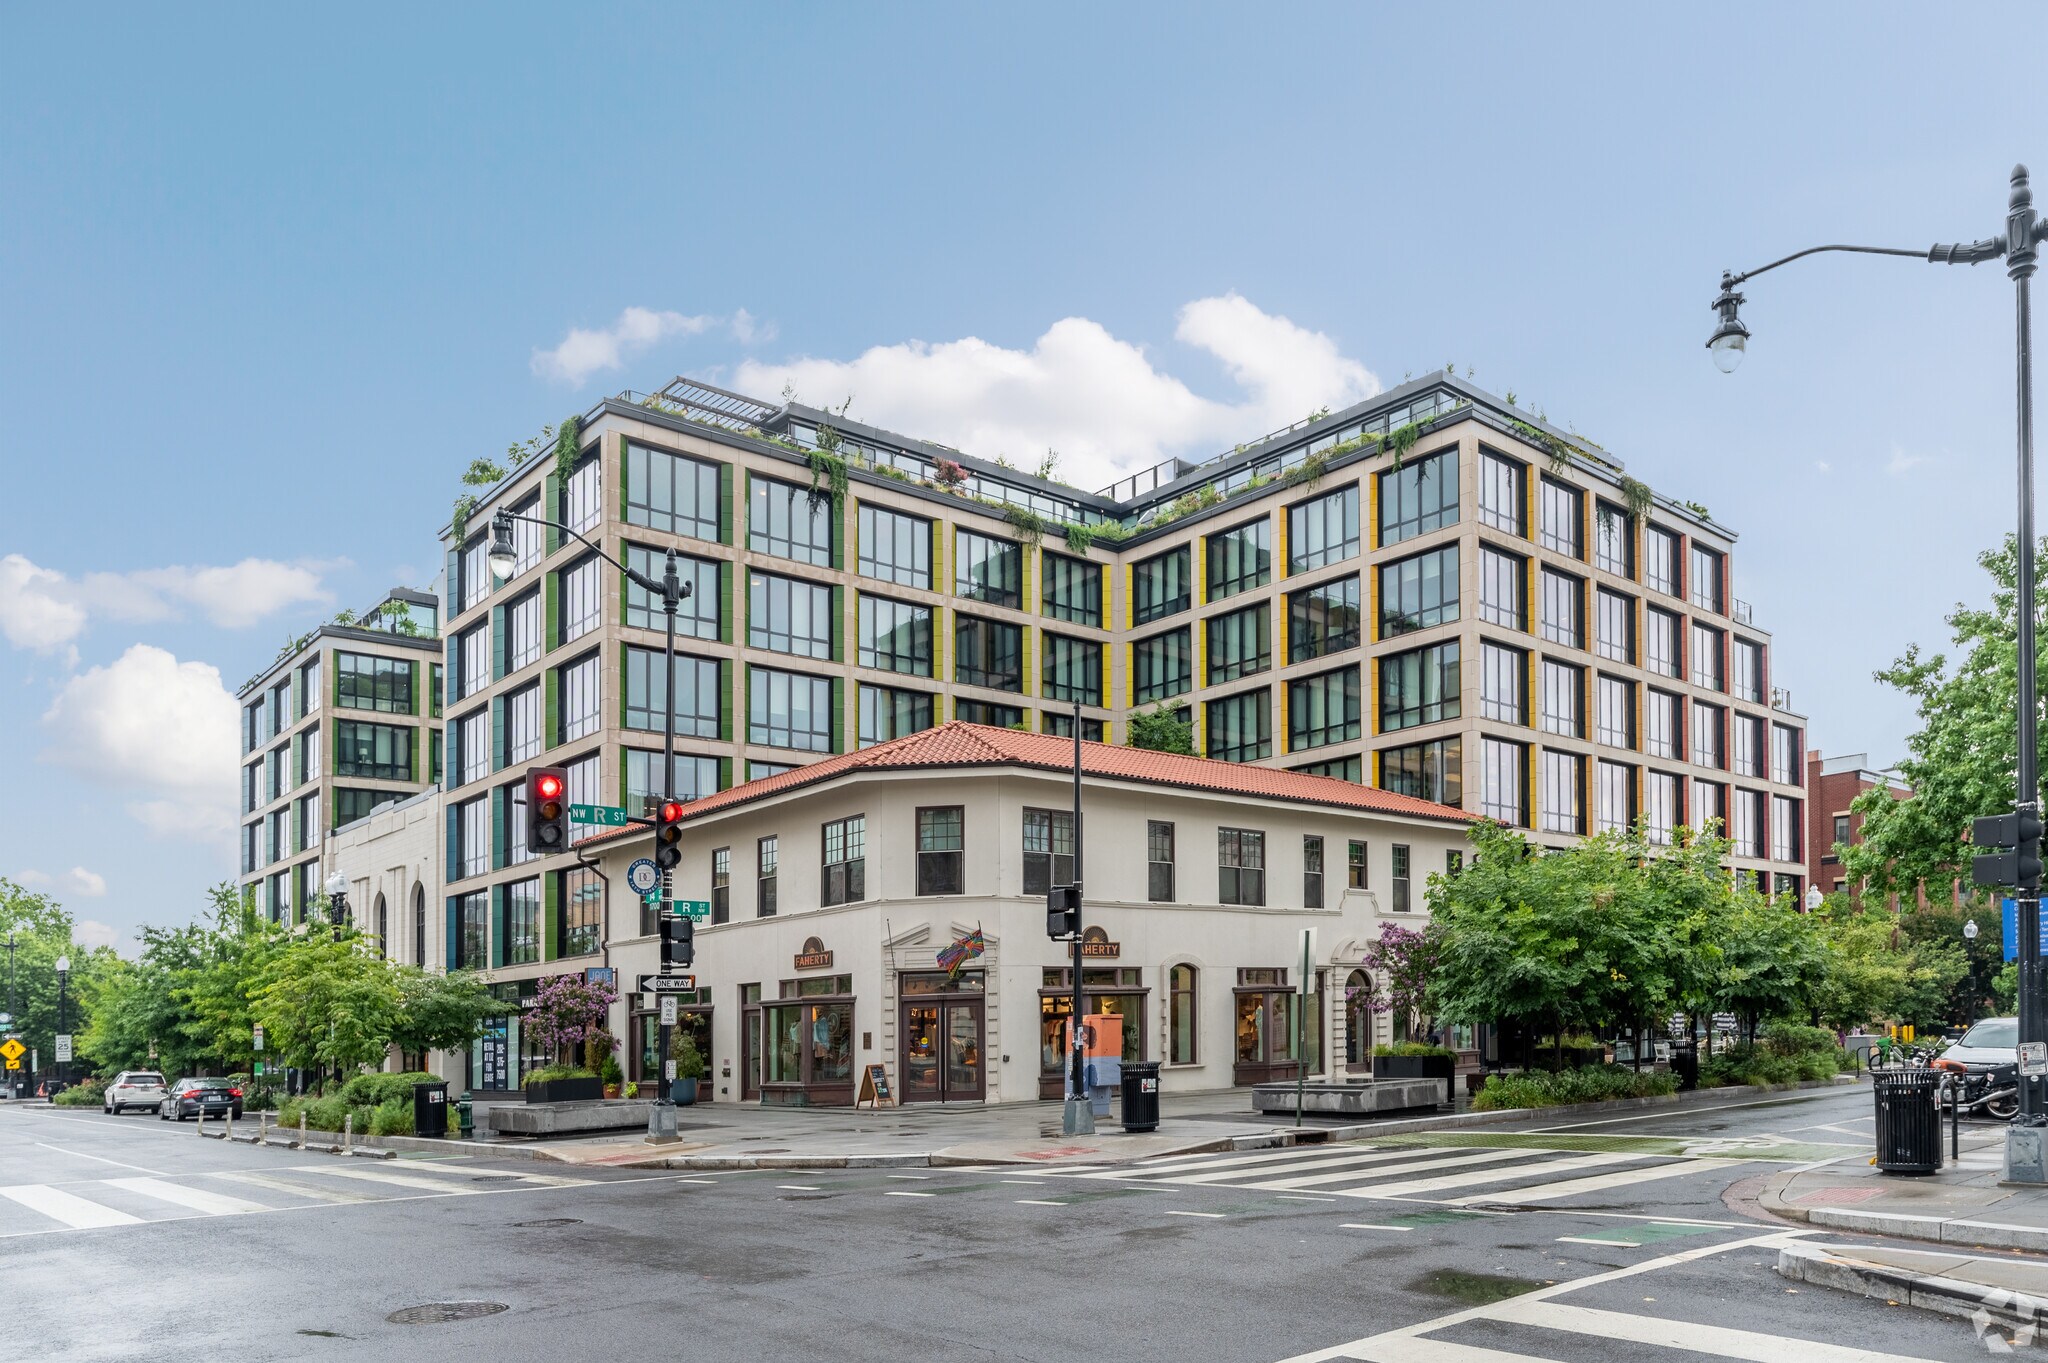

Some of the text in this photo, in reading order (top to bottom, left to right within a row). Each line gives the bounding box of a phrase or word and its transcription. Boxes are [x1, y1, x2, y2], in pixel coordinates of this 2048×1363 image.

[572, 807, 624, 823] NW R ST
[632, 859, 656, 868] GREATER
[639, 872, 651, 881] DC
[682, 902, 690, 912] R
[795, 953, 829, 966] FAHERTY
[589, 970, 611, 981] JANE
[483, 1042, 494, 1051] RETAIL
[484, 1073, 494, 1082] LEASE
